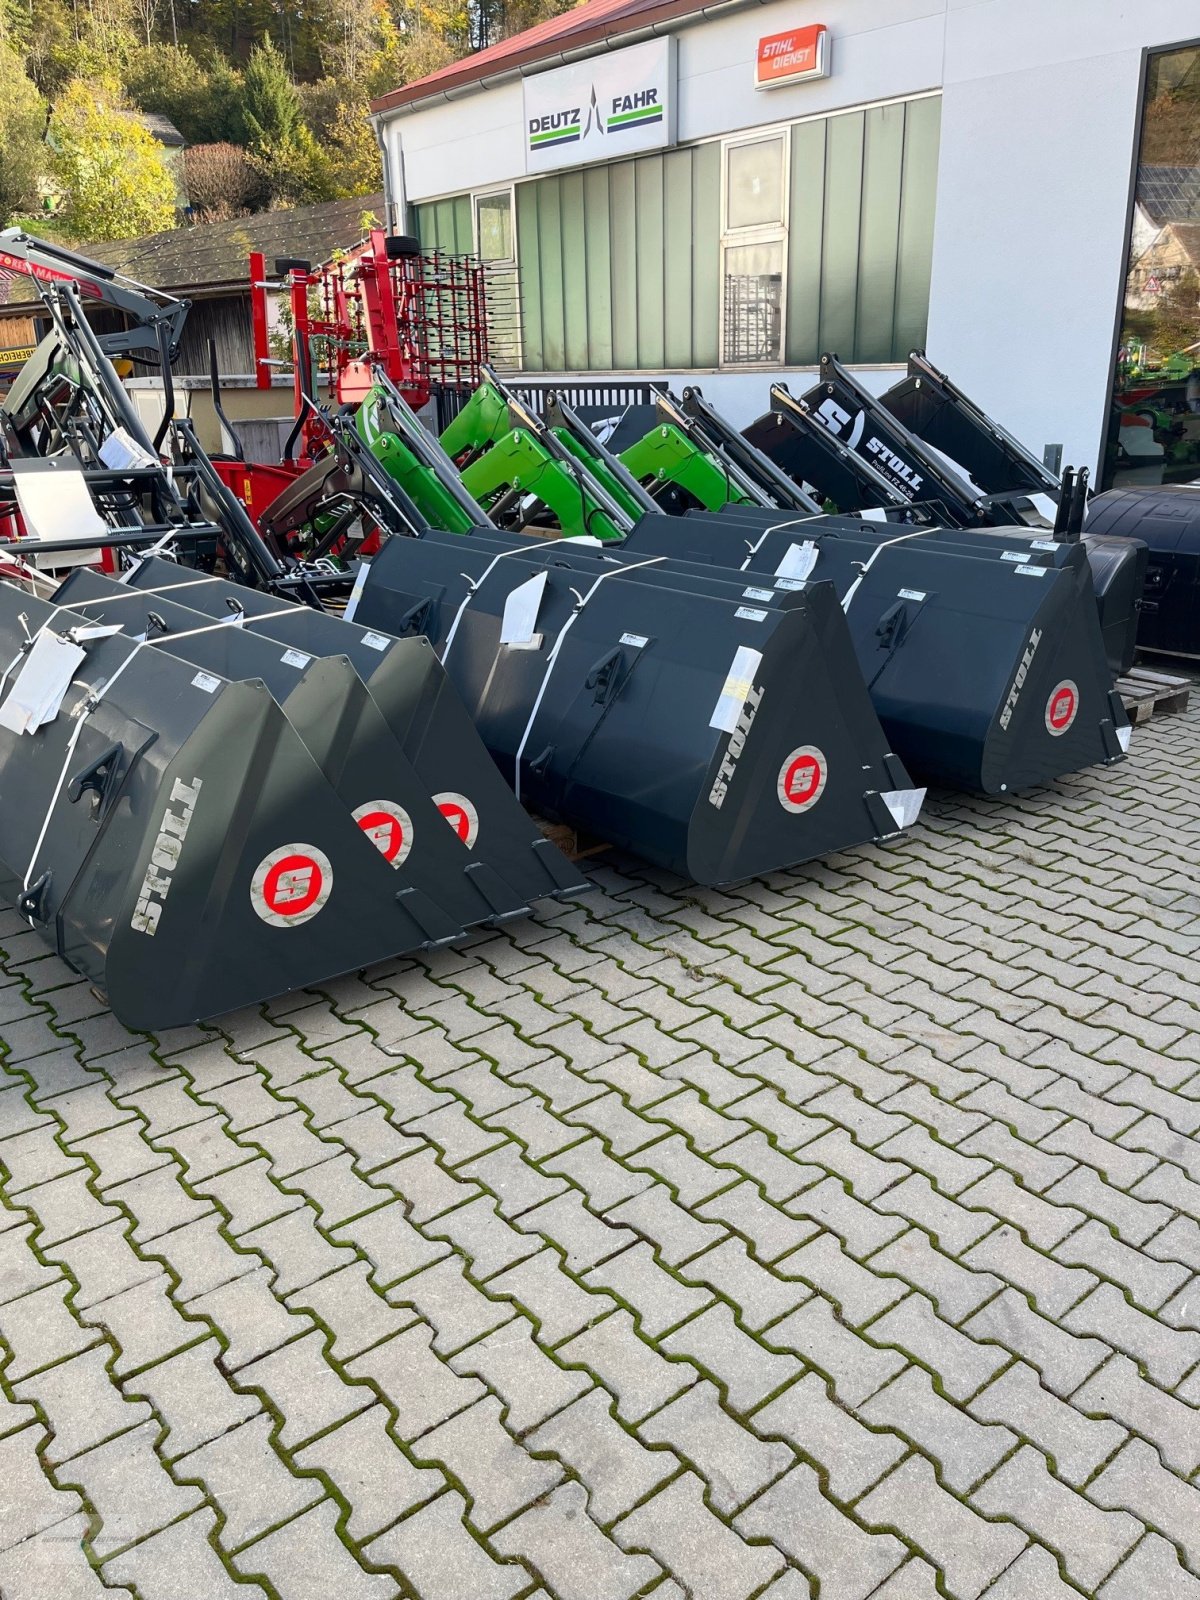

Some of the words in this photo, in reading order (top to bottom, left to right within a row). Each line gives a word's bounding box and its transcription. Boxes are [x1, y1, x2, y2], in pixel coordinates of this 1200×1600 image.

[762, 38, 794, 58] STIHL
[773, 49, 811, 69] DIENST
[529, 108, 581, 134] DEUTZ
[612, 88, 658, 114] FAHR
[865, 437, 924, 491] STOLL
[871, 459, 892, 480] ProfiLine
[891, 477, 901, 486] FZ
[999, 627, 1043, 731] STOLL
[708, 684, 765, 810] STOLL
[789, 765, 816, 795] S
[130, 776, 203, 936] STOLL
[273, 866, 314, 905] S
